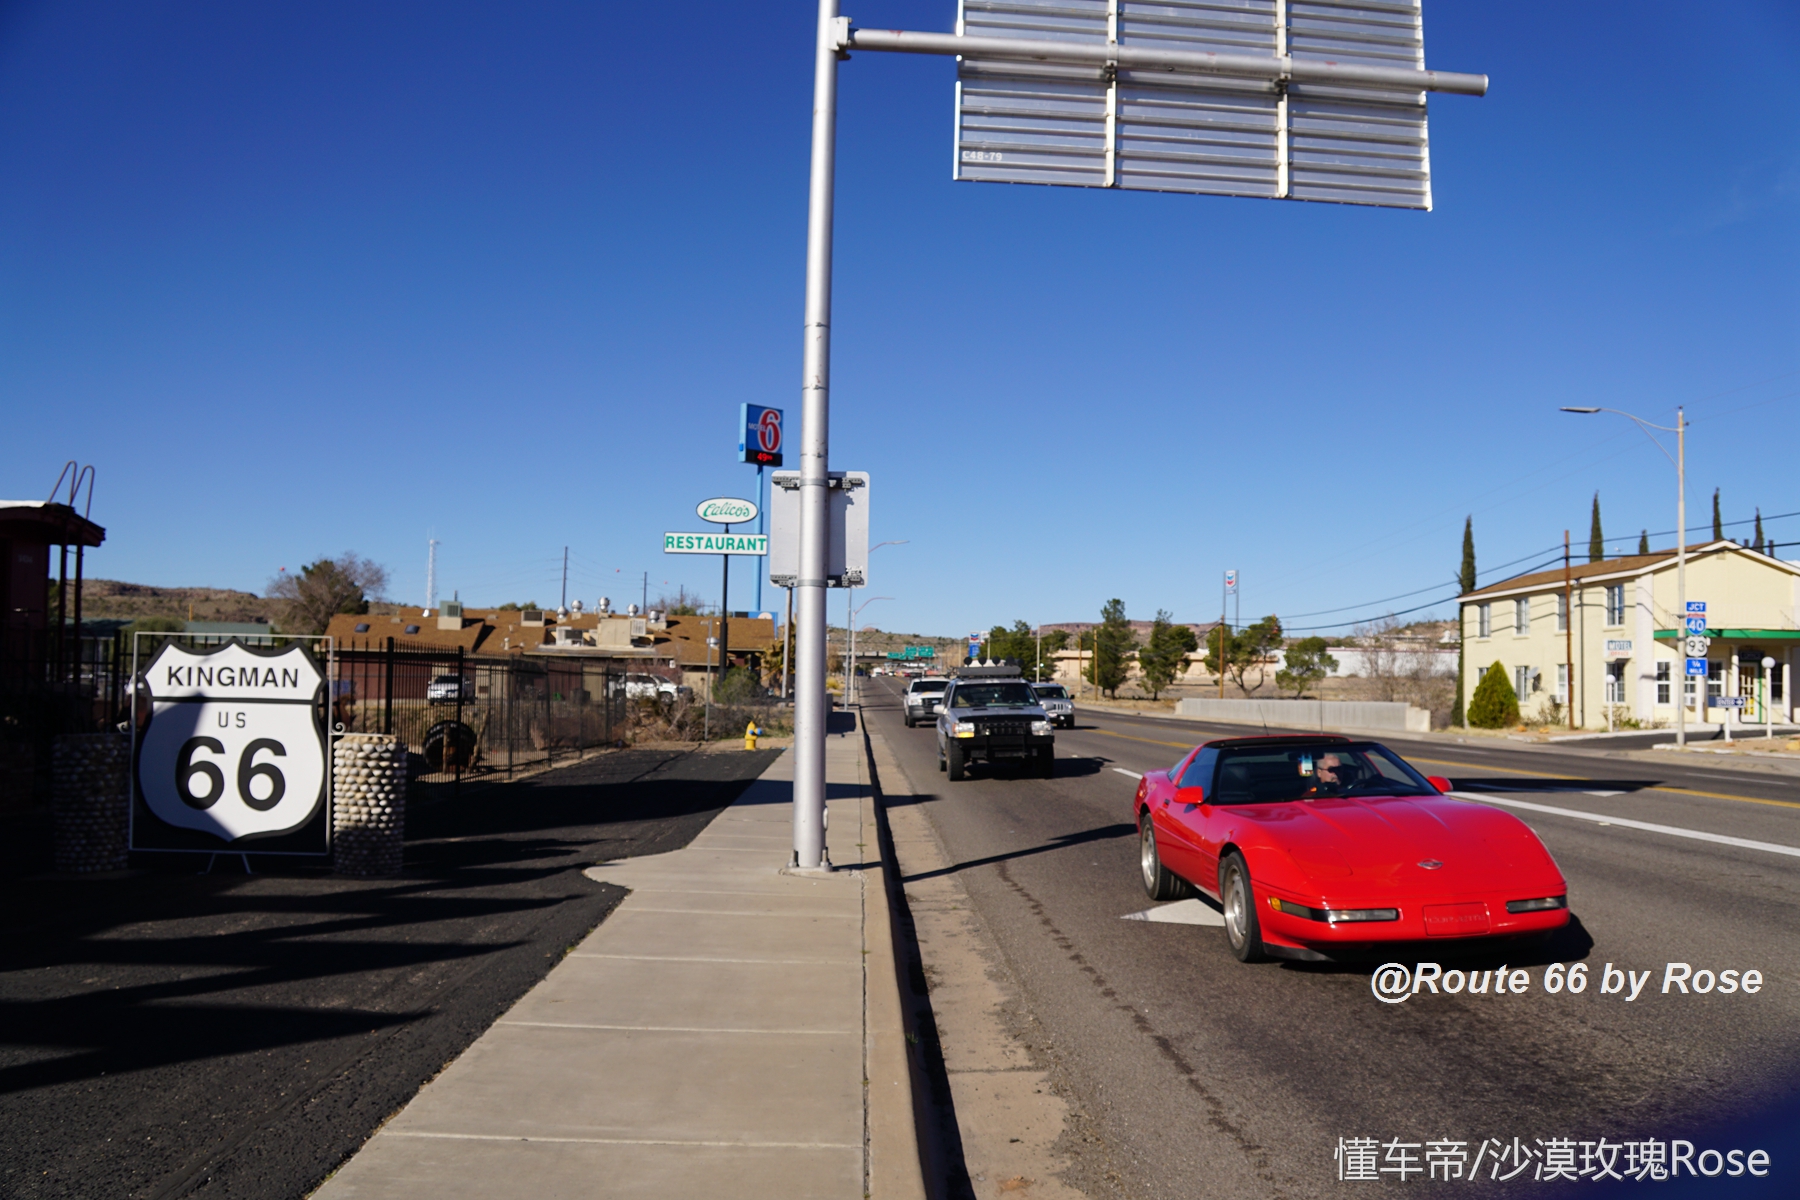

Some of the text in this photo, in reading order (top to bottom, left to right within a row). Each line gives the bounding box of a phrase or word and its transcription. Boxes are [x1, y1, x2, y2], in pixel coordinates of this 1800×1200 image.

[962, 151, 1002, 162] C48-79
[758, 409, 781, 453] 6
[703, 502, 750, 517] Calico's
[665, 536, 767, 551] RESTAURANT
[1688, 603, 1705, 611] JCT
[1688, 620, 1705, 631] 40
[1608, 641, 1632, 650] MOTEL
[1689, 640, 1706, 652] 93
[167, 666, 298, 688] KINGMAN
[218, 712, 246, 729] US
[175, 736, 287, 812] 66
